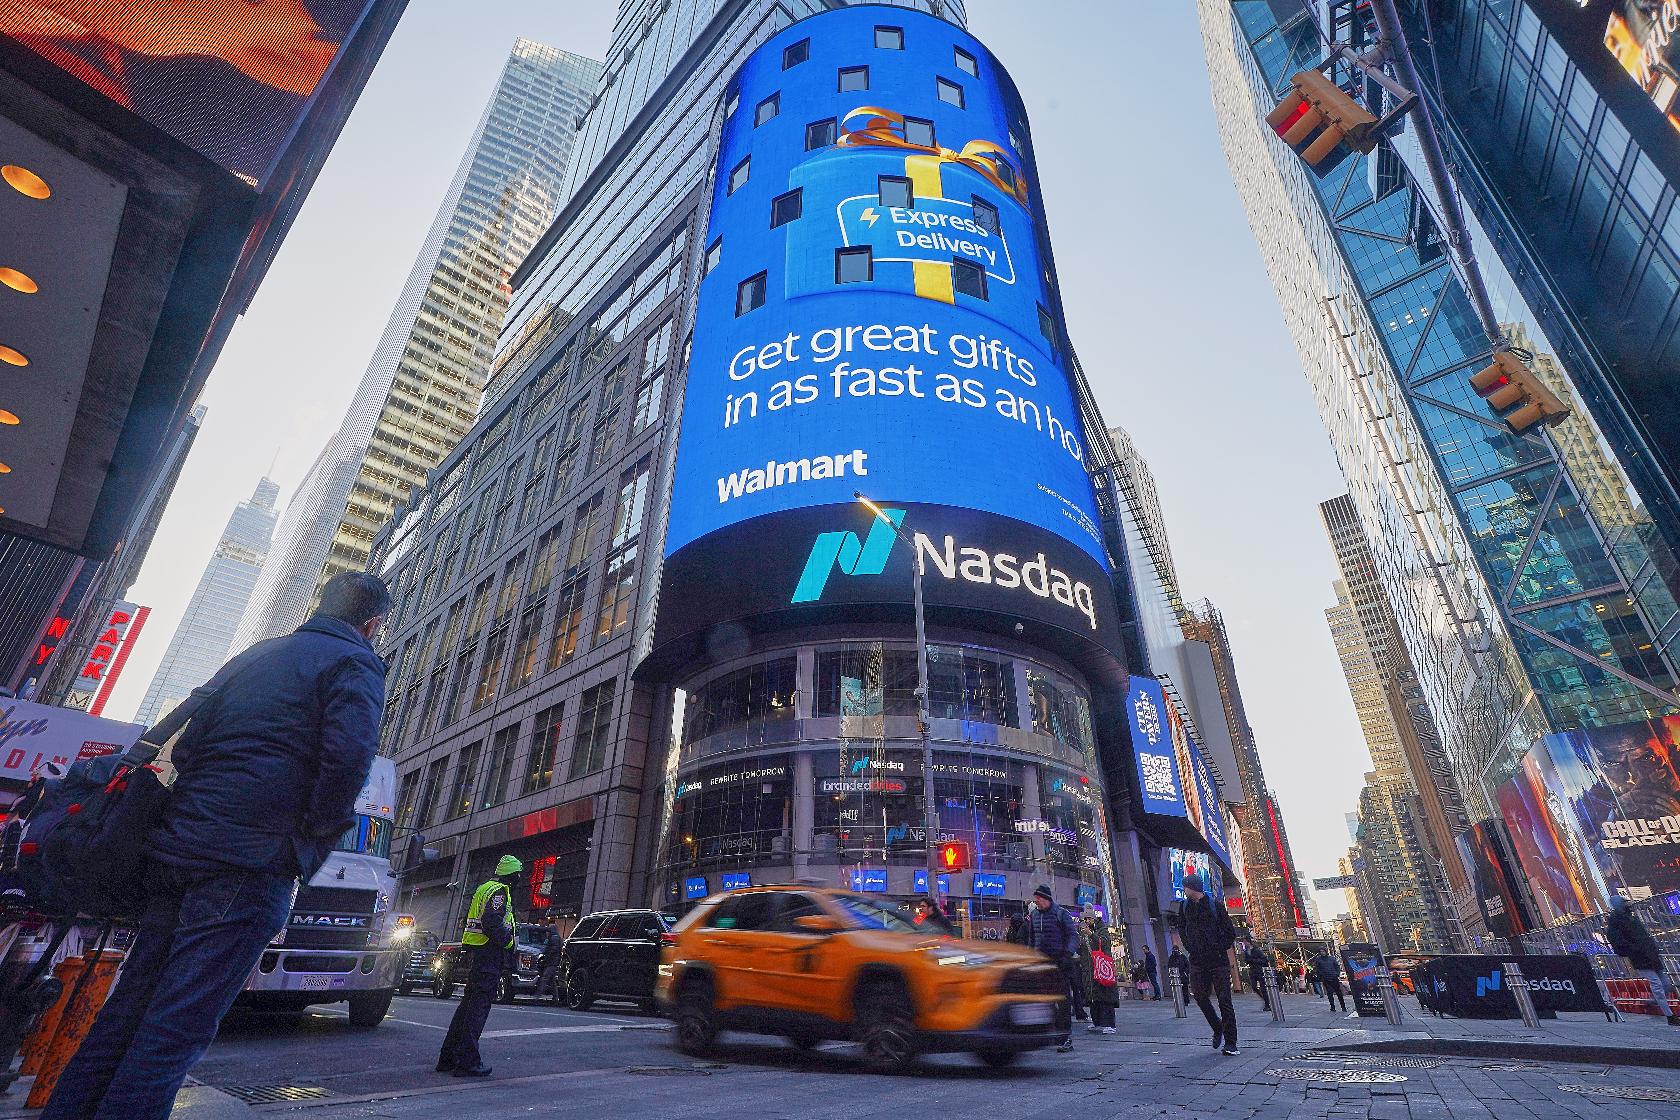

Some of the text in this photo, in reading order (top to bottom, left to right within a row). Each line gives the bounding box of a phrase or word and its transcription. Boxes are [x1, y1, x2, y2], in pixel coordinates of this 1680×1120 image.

[889, 207, 988, 238] Express
[896, 230, 996, 267] Delivery
[729, 323, 1037, 388] Get great gifts
[724, 391, 758, 429] in
[767, 374, 819, 411] as
[830, 362, 925, 398] fast
[935, 372, 987, 408] as
[995, 387, 1042, 431] an
[718, 449, 868, 503] Walmart
[914, 532, 1097, 630] Nasdaq
[82, 611, 129, 679] PARK
[870, 760, 904, 772] Nasdaq
[962, 766, 1007, 779] TOMORROW
[710, 767, 785, 786] REWRITE TOMORROW
[909, 828, 956, 842] Nadaq
[1602, 818, 1654, 838] CALL
[1601, 834, 1671, 849] BLACK
[293, 915, 366, 926] MACK
[1505, 976, 1576, 994] asdaq
